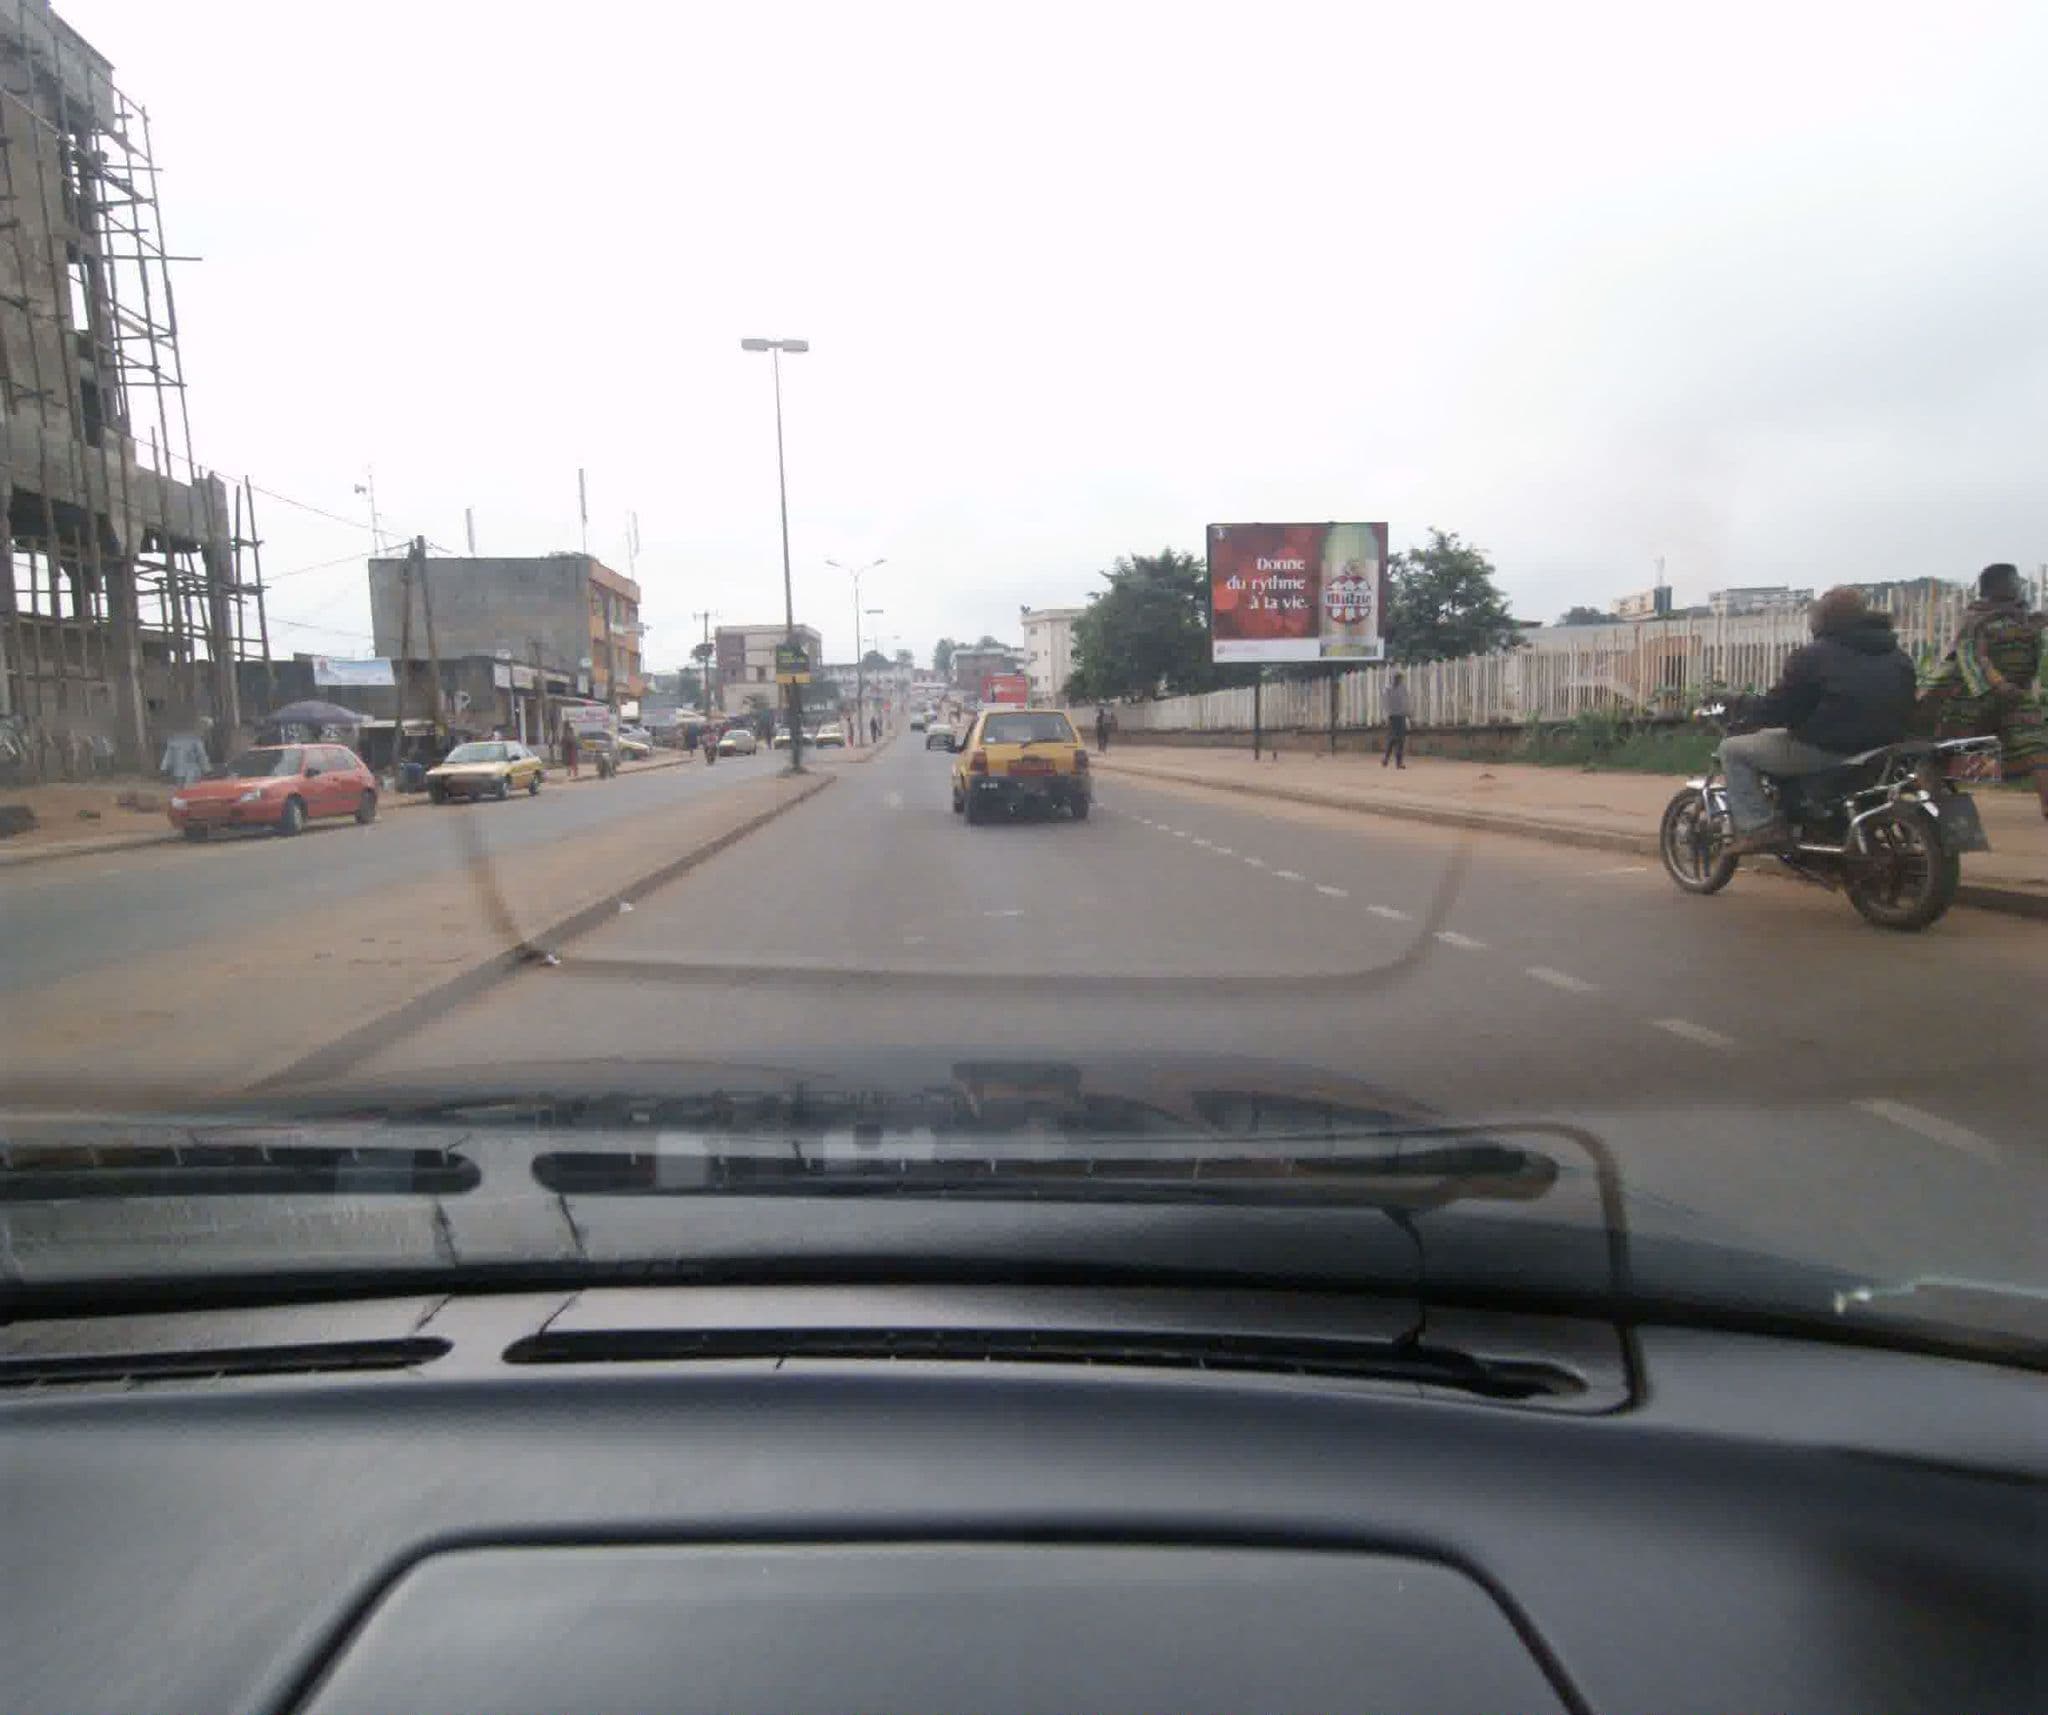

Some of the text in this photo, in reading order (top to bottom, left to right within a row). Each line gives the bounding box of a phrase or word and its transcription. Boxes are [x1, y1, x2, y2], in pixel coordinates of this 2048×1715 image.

[1256, 557, 1305, 570] Donne
[1226, 575, 1305, 595] du rythme
[1264, 596, 1278, 609] la
